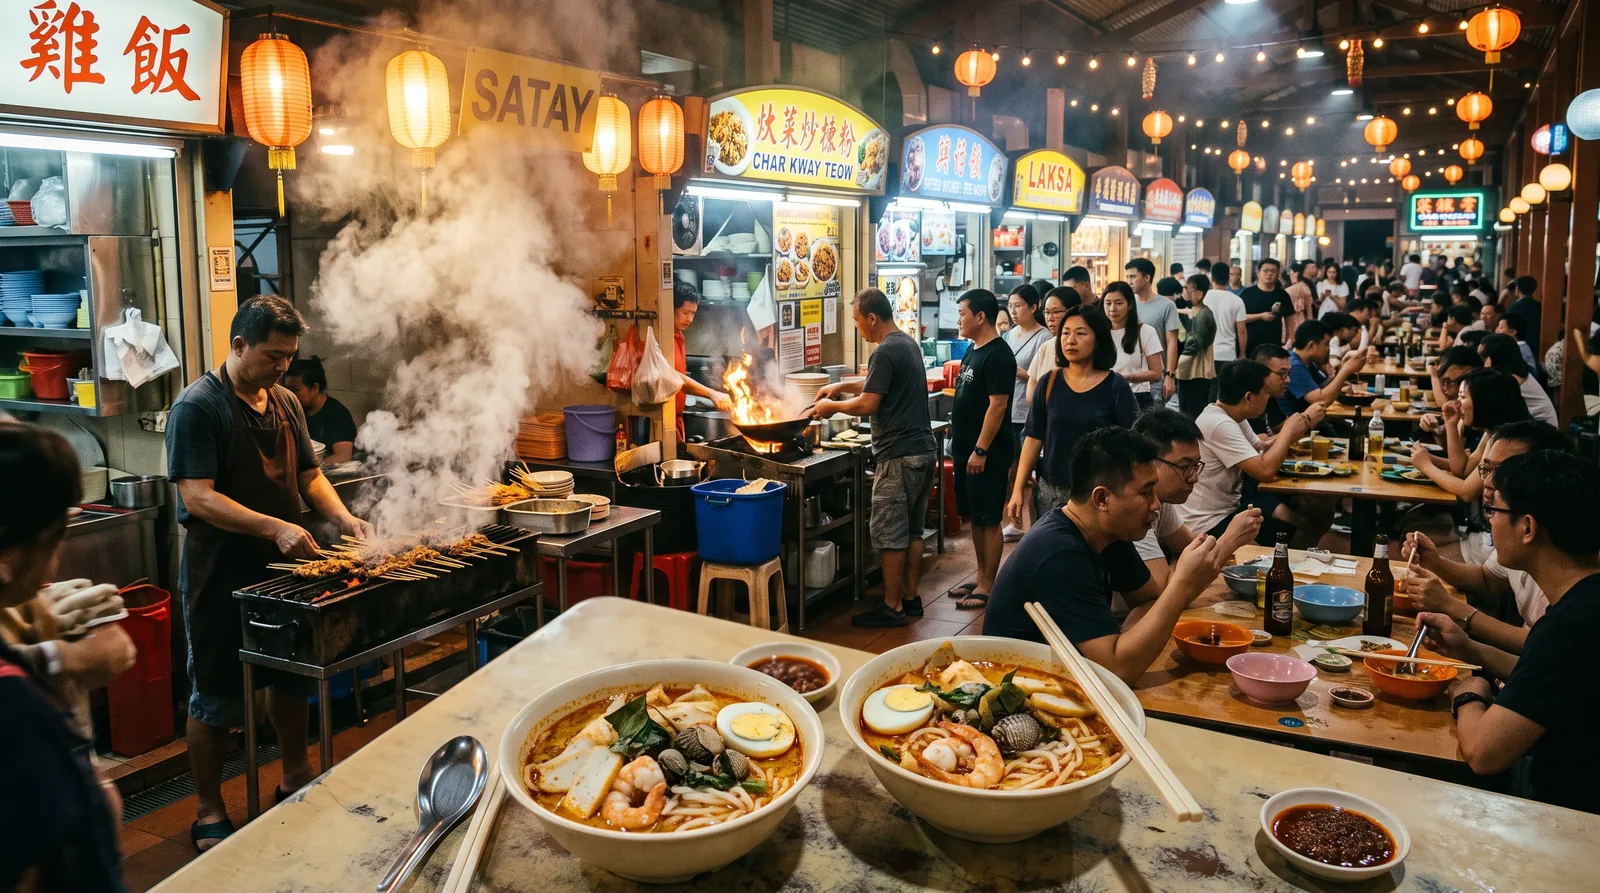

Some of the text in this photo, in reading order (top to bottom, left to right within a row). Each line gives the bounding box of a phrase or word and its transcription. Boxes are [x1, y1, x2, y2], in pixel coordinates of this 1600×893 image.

[20, 0, 201, 101] 雞飯
[472, 69, 595, 133] SATAY
[753, 152, 786, 172] CHAR
[790, 157, 821, 176] KWAY
[825, 162, 853, 180] TEOW
[1029, 161, 1072, 192] LAKSA
